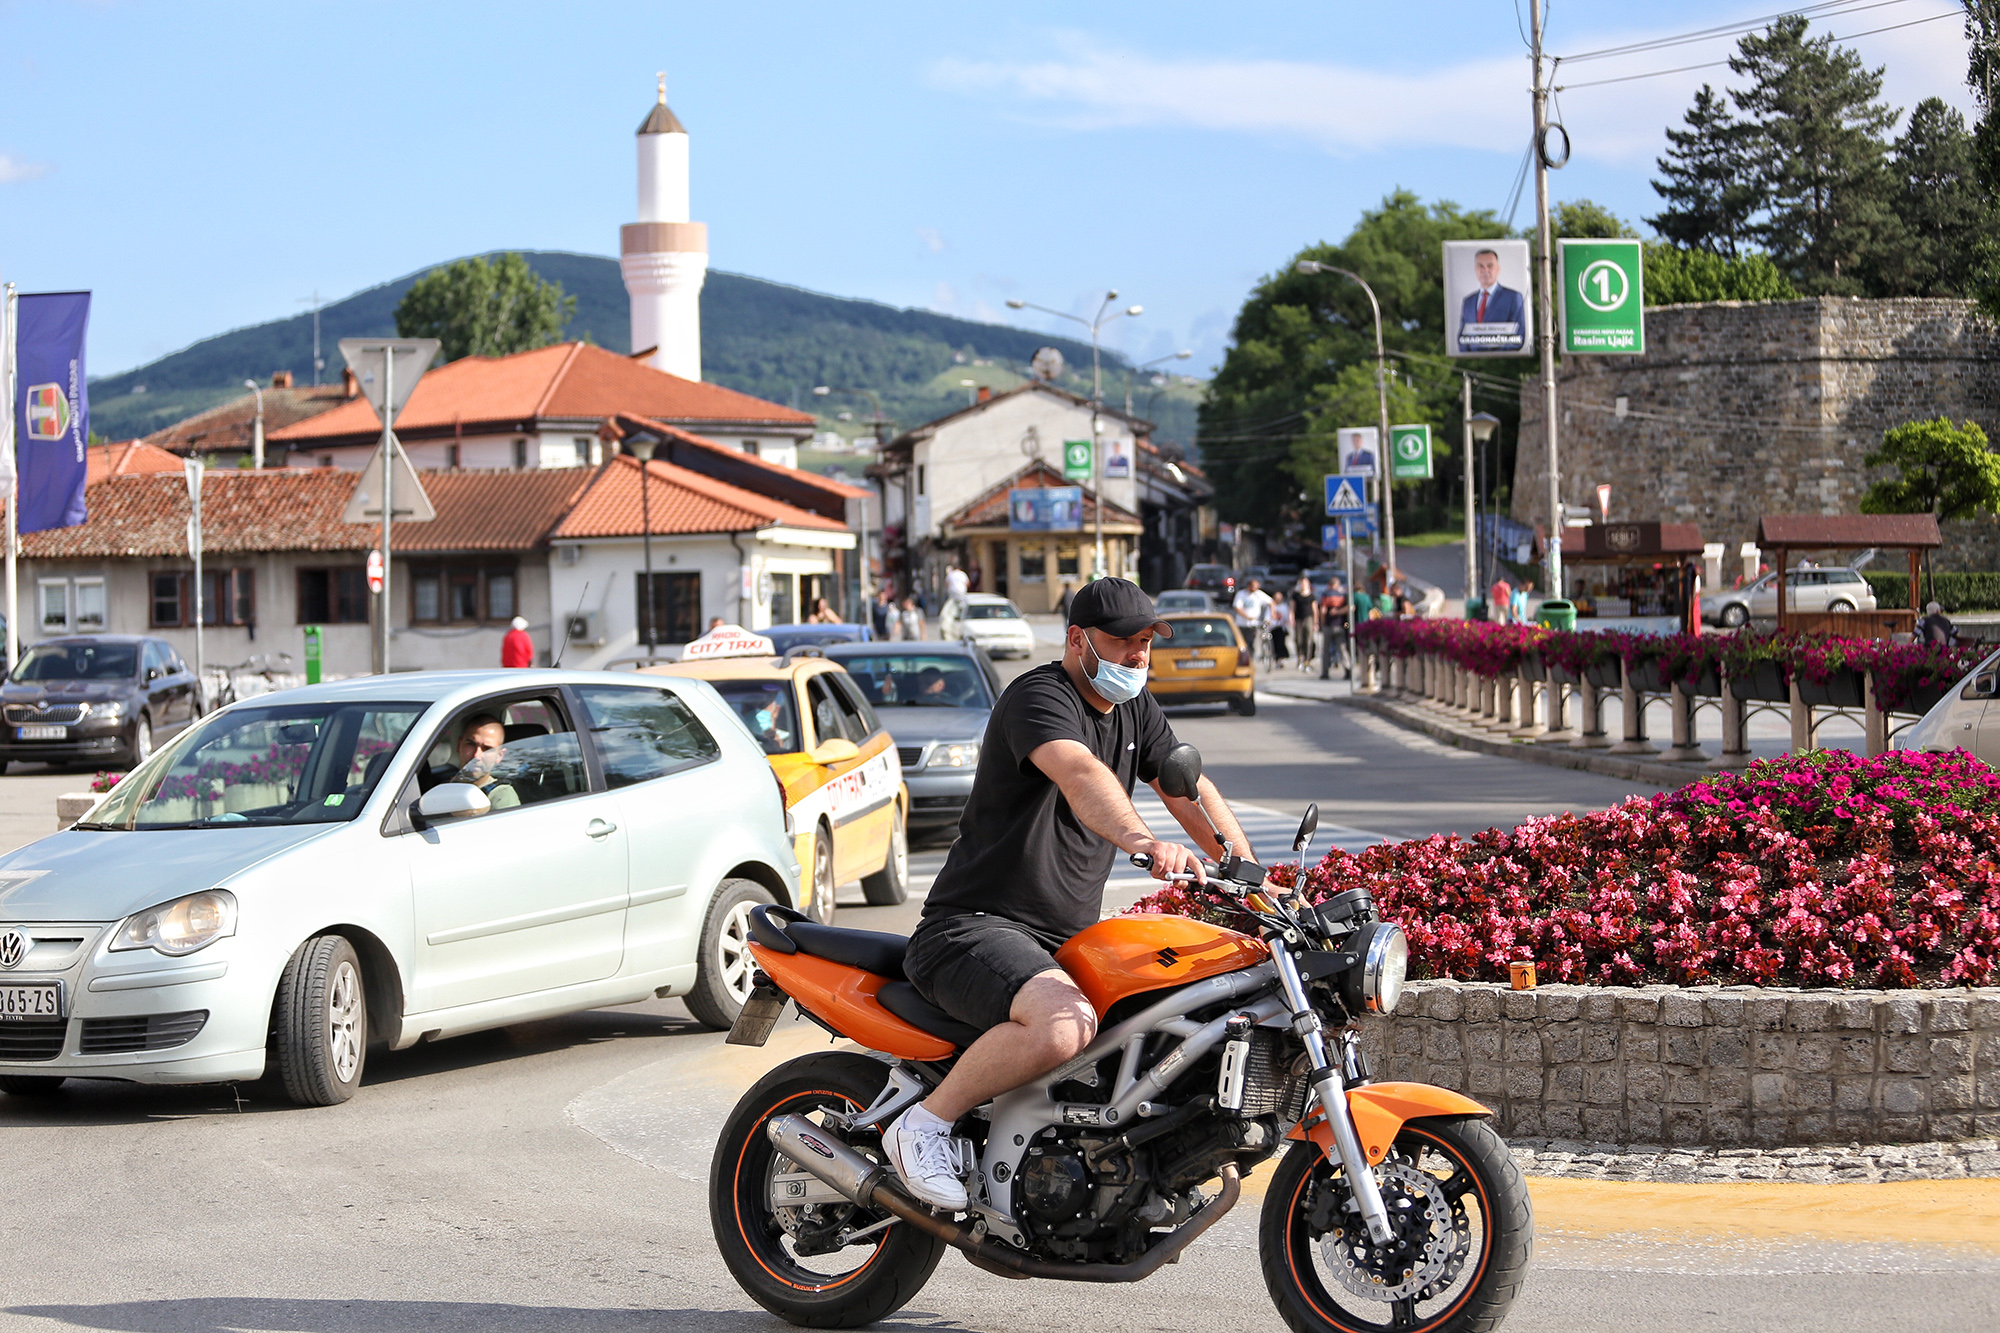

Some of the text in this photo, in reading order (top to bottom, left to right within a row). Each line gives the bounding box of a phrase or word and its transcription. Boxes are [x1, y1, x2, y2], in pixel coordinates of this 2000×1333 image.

[1592, 268, 1618, 302] 1.
[1573, 335, 1634, 348] Rasim Ljajić
[711, 631, 741, 640] RADIO
[690, 639, 764, 655] CITY TAXI
